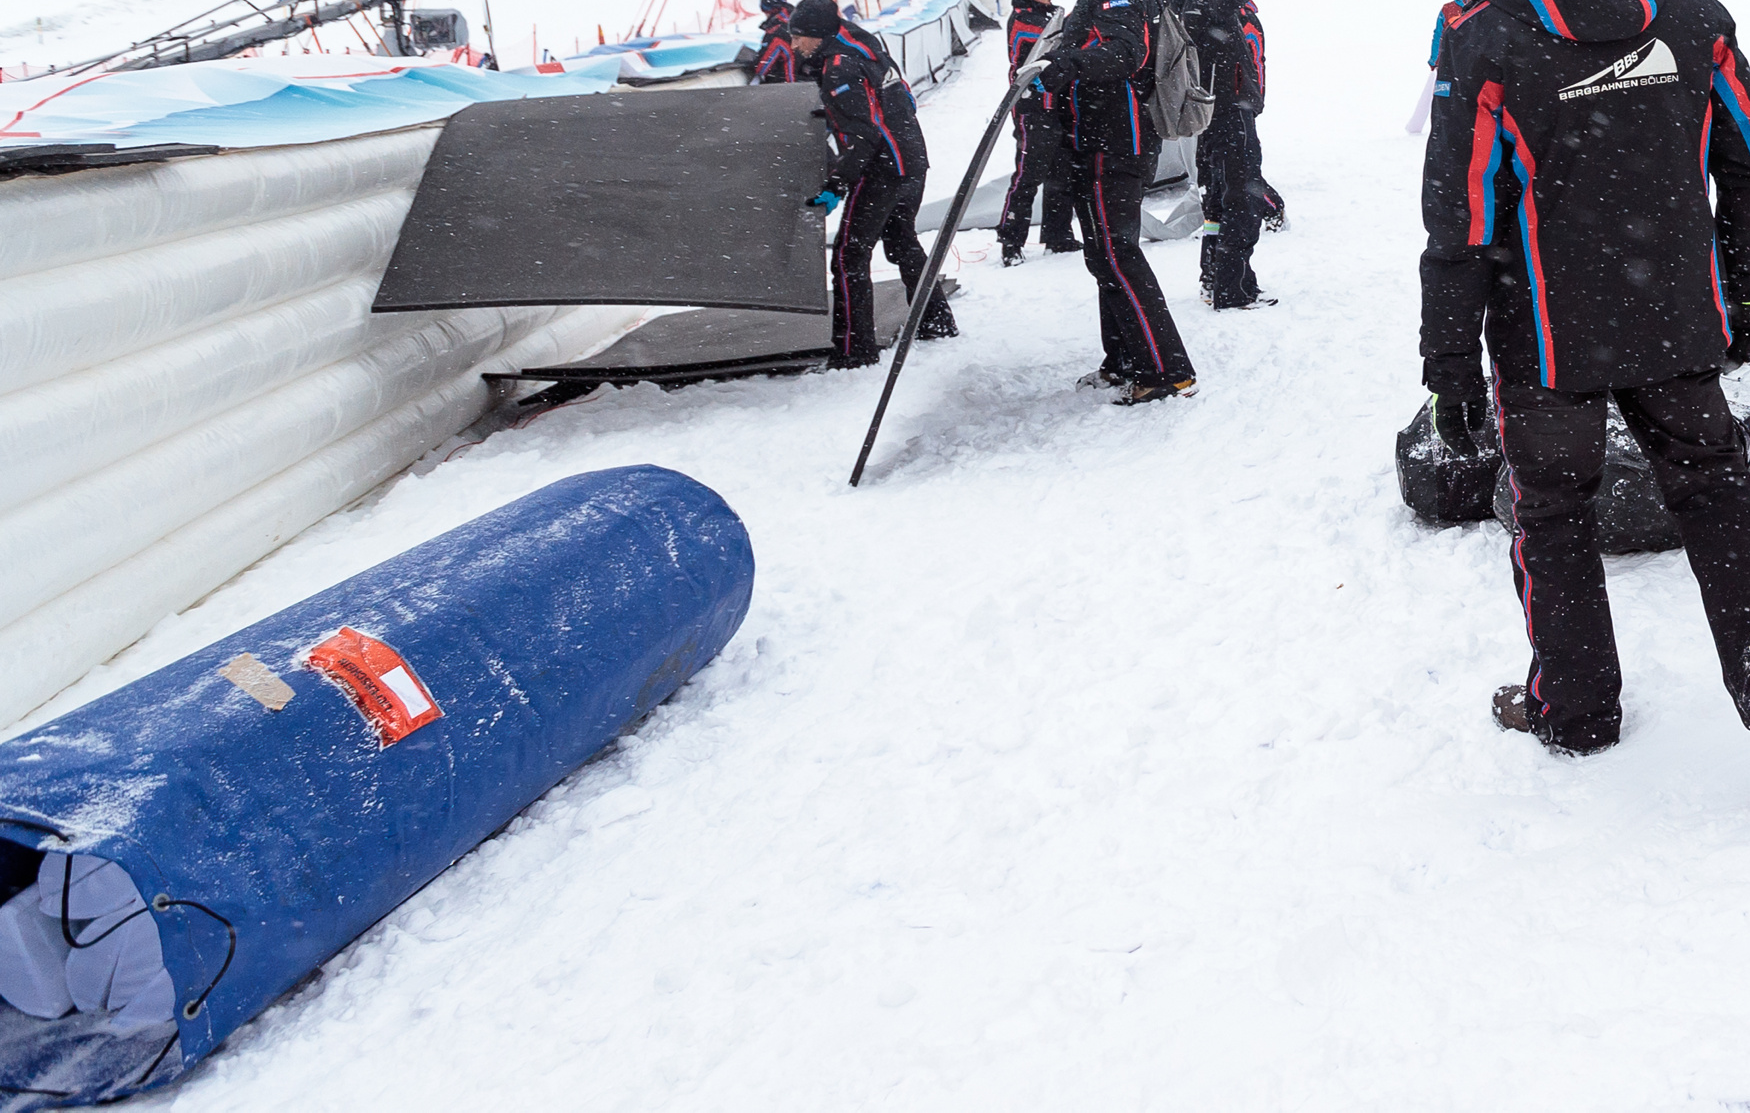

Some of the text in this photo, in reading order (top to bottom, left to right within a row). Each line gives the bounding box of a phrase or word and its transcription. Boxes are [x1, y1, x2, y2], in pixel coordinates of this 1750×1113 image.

[1613, 50, 1639, 79] BBS
[1559, 74, 1680, 101] BERGBAHNEN SÖLDEN
[337, 657, 394, 712] LIEFERSCHEIN
